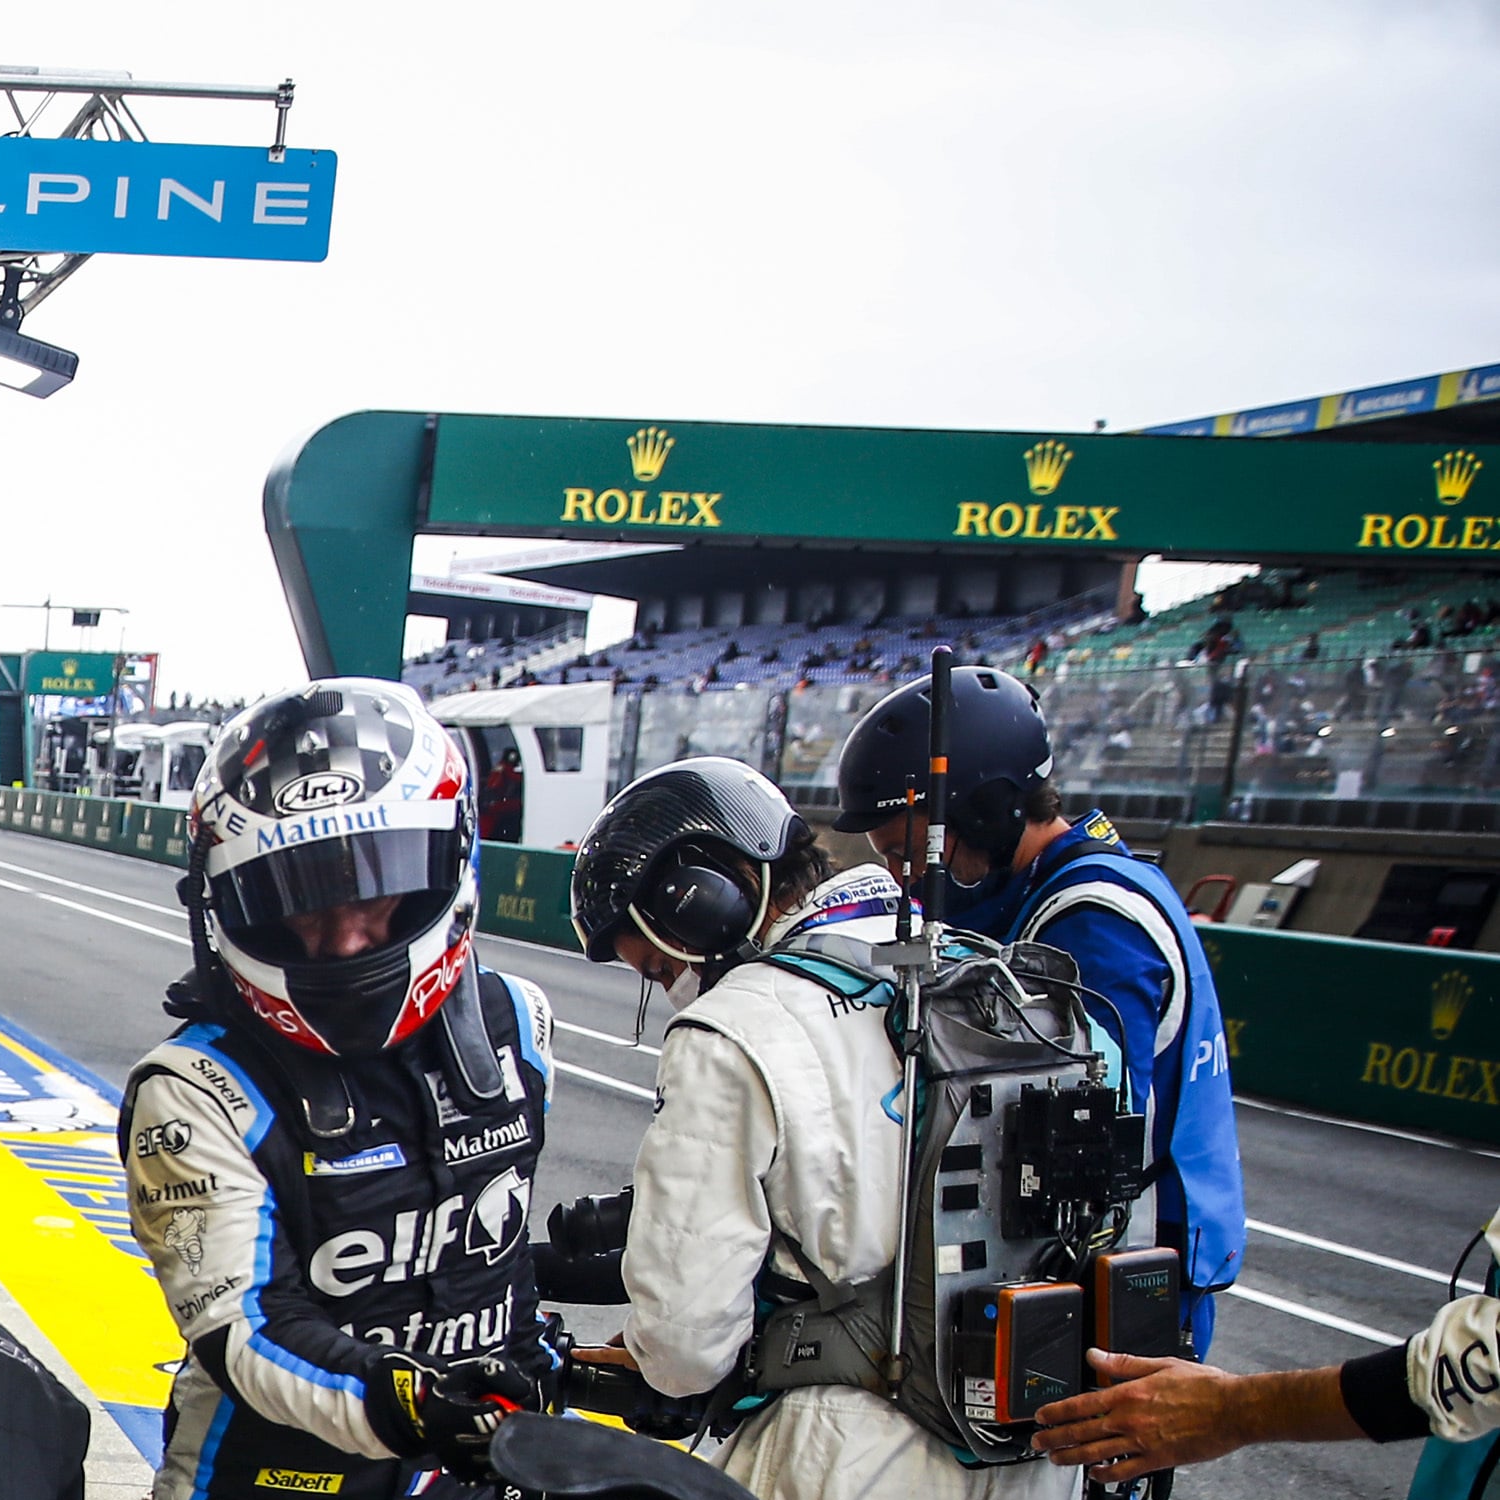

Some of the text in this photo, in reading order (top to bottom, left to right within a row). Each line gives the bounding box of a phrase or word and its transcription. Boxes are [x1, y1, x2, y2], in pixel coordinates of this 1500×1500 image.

[560, 487, 722, 527] ROLEX
[953, 501, 1120, 541] ROLEX
[1357, 512, 1500, 550] ROLE
[41, 676, 95, 692] ROLEX
[256, 803, 390, 856] Matmut
[191, 1056, 250, 1114] Sabelt
[1361, 1040, 1500, 1107] ROLEX
[135, 1130, 164, 1157] elf
[443, 1113, 530, 1161] Matmut
[309, 1194, 465, 1298] elf
[174, 1274, 244, 1322] thiriet
[264, 1469, 334, 1492] Sabelt
